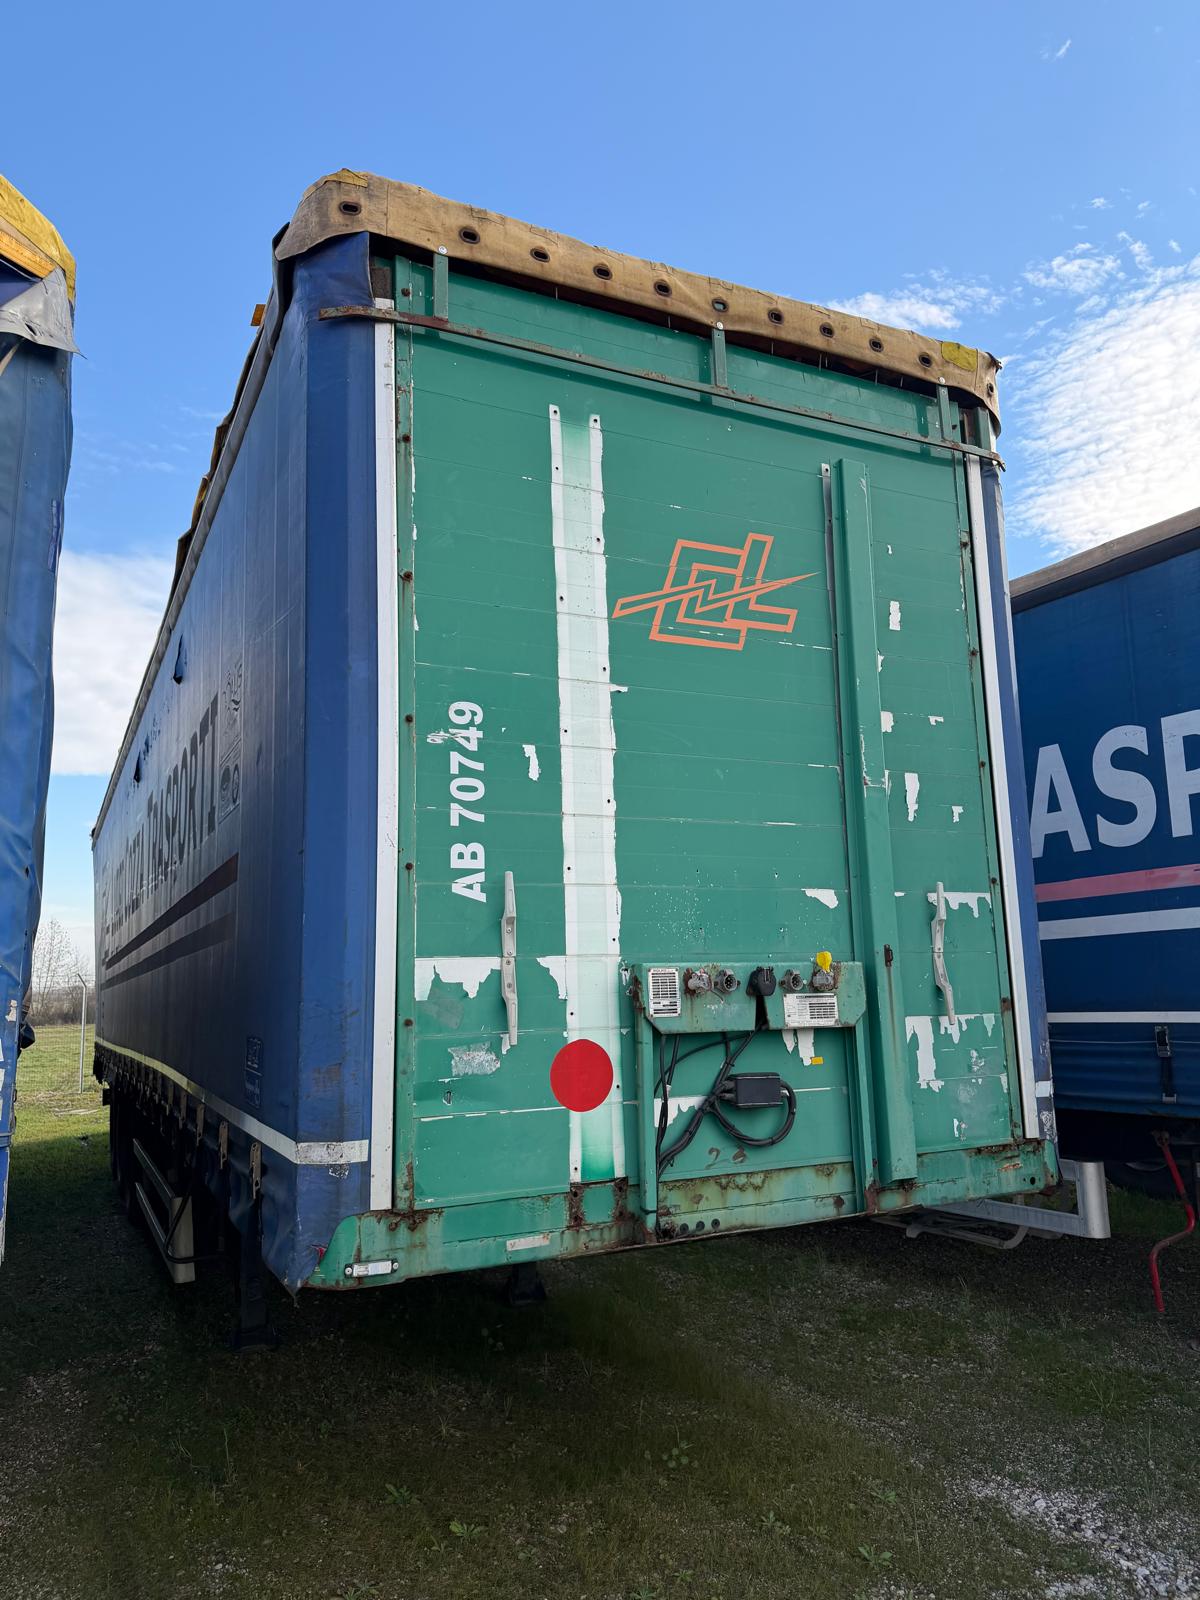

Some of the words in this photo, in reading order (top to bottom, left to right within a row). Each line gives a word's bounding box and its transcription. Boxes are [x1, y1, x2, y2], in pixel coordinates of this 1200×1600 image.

[147, 691, 218, 898] TRASPORTI
[448, 701, 485, 827] 70749
[451, 842, 486, 903] AB
